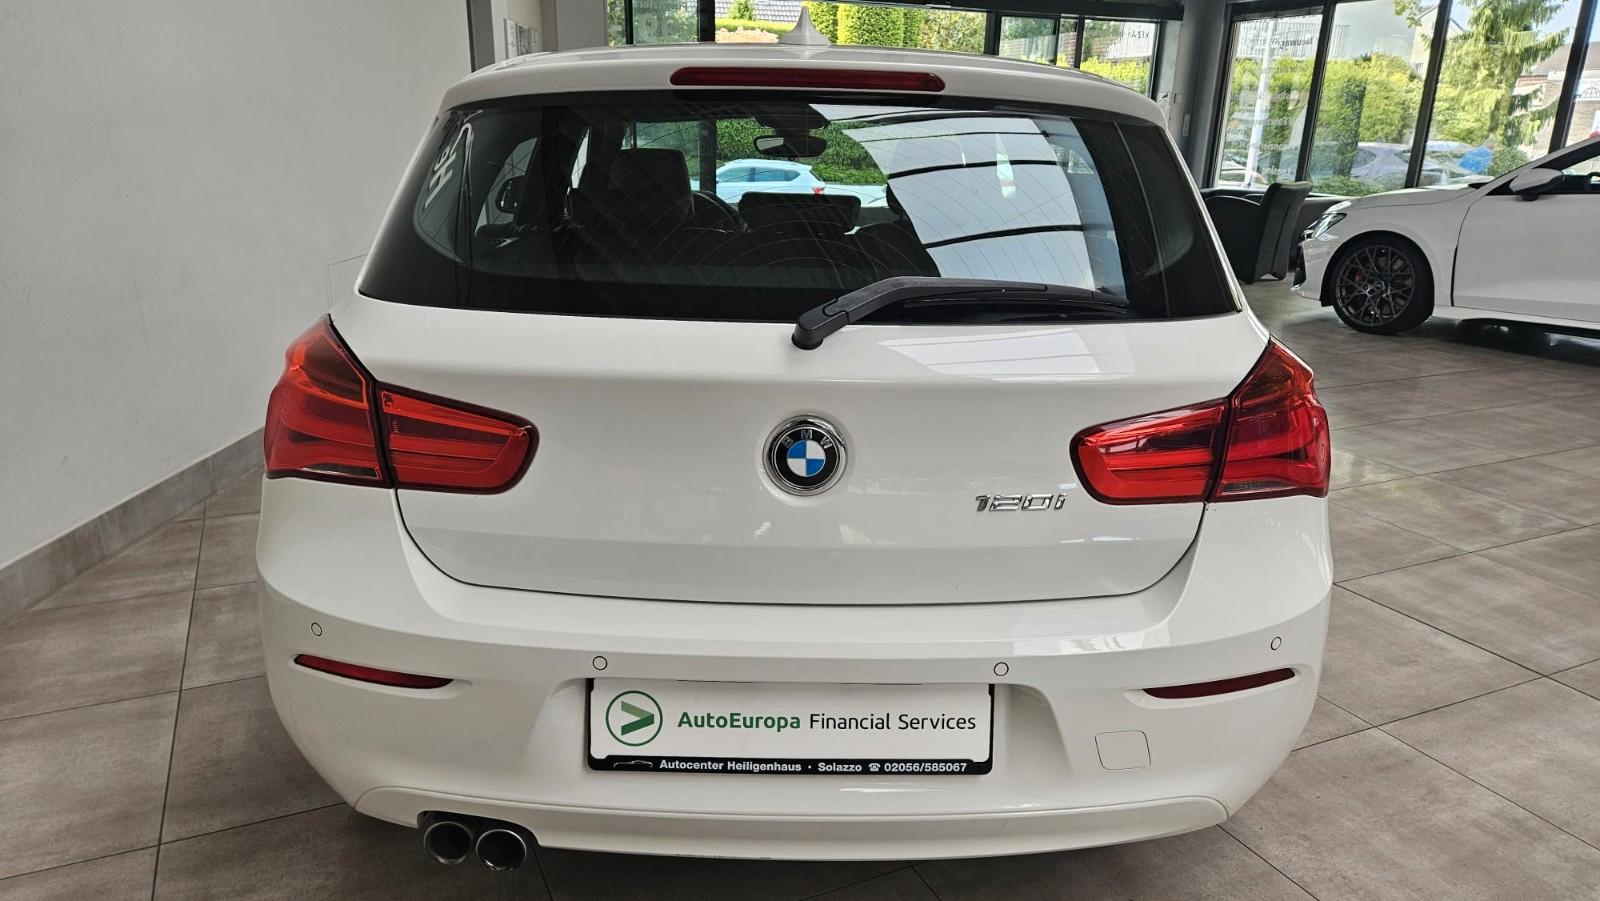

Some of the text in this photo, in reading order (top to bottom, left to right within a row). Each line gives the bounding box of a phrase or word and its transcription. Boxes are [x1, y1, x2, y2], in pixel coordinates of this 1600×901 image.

[780, 429, 833, 449] BMW
[975, 494, 1067, 512] 120i
[677, 711, 977, 733] AutoEuropa Financial Services
[659, 759, 968, 773] Autocenter Heiligenhaus Solazzo 02056/585067
